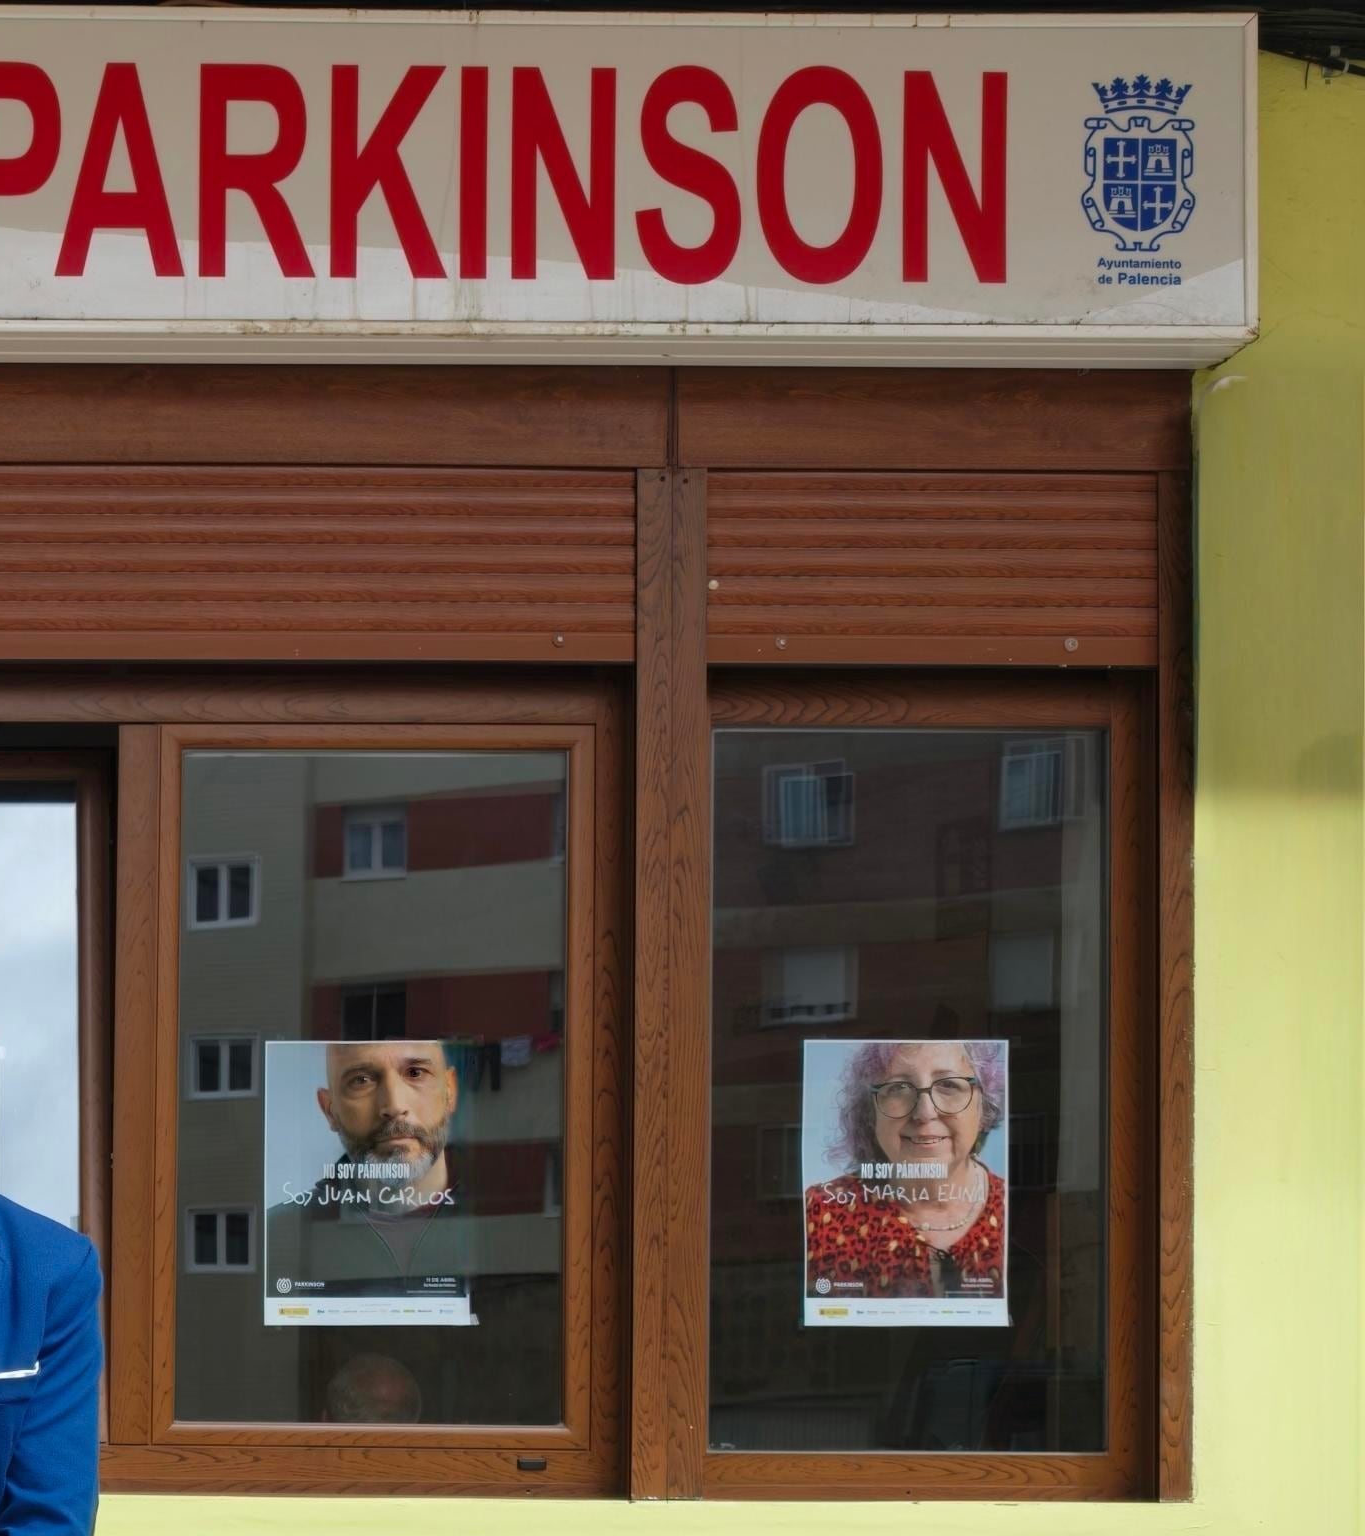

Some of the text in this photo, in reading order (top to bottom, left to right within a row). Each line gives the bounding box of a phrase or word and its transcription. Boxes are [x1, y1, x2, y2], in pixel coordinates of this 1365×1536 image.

[1097, 257, 1182, 271] Ayuntamiento
[1098, 273, 1182, 285] de Palencia
[323, 1160, 410, 1179] NO SOY PÁRKINSON
[861, 1163, 873, 1179] NO
[875, 1163, 893, 1179] SOY
[318, 1184, 371, 1205] JUAN
[378, 1186, 455, 1206] CARLOS
